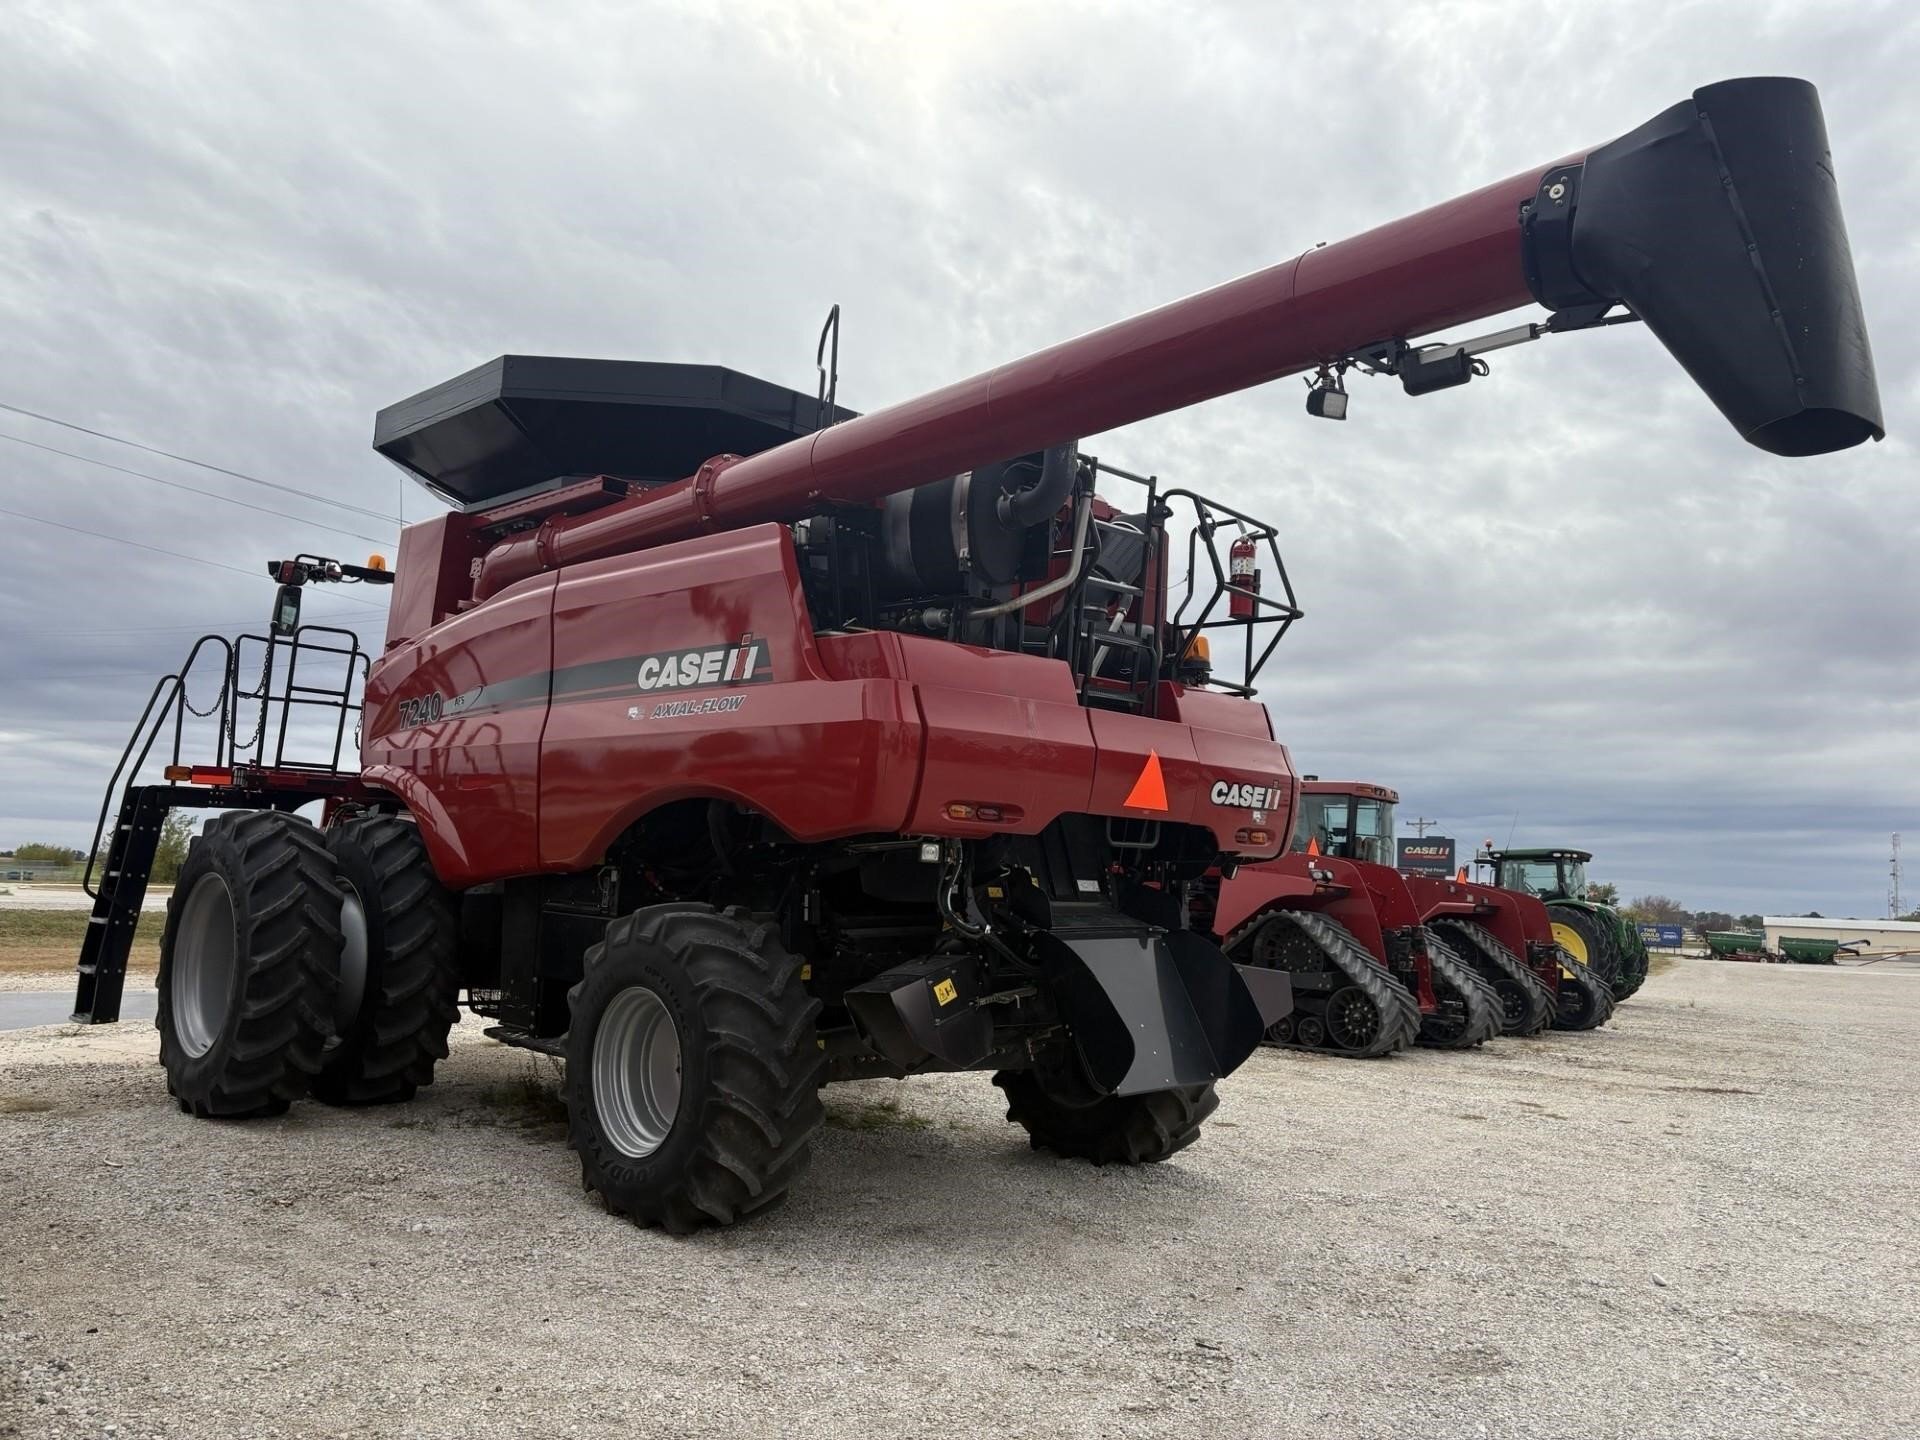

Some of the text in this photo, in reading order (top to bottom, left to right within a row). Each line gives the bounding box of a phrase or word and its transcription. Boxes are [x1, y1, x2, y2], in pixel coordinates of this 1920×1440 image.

[638, 650, 724, 690] CASE
[399, 691, 442, 731] 7240
[650, 695, 747, 719] AXIAL-FLOW
[1211, 781, 1266, 809] CASE
[1404, 846, 1437, 855] CASE
